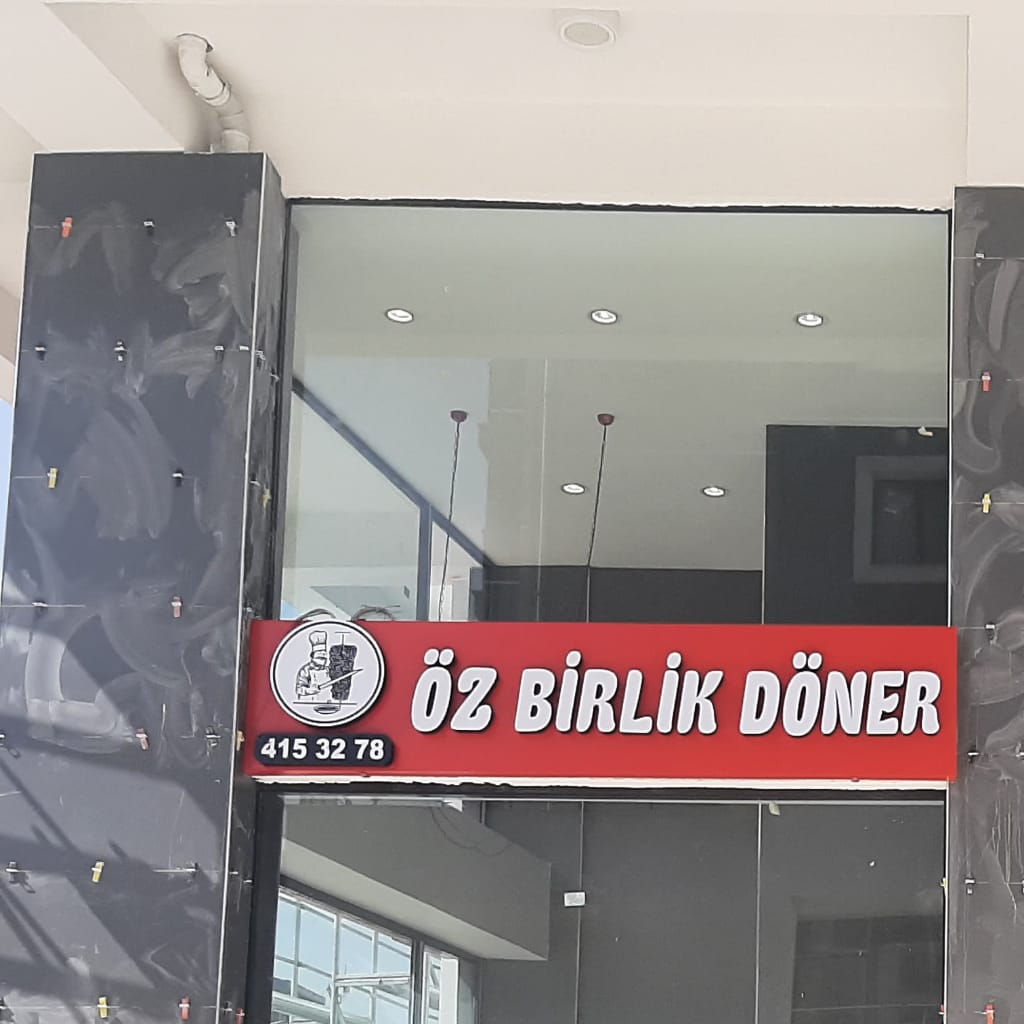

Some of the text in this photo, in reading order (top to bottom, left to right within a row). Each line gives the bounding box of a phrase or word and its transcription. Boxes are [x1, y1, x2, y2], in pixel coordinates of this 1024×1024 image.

[411, 649, 940, 736] ÖZ BİRLİK DÖNER
[261, 738, 384, 760] 415 32 78
